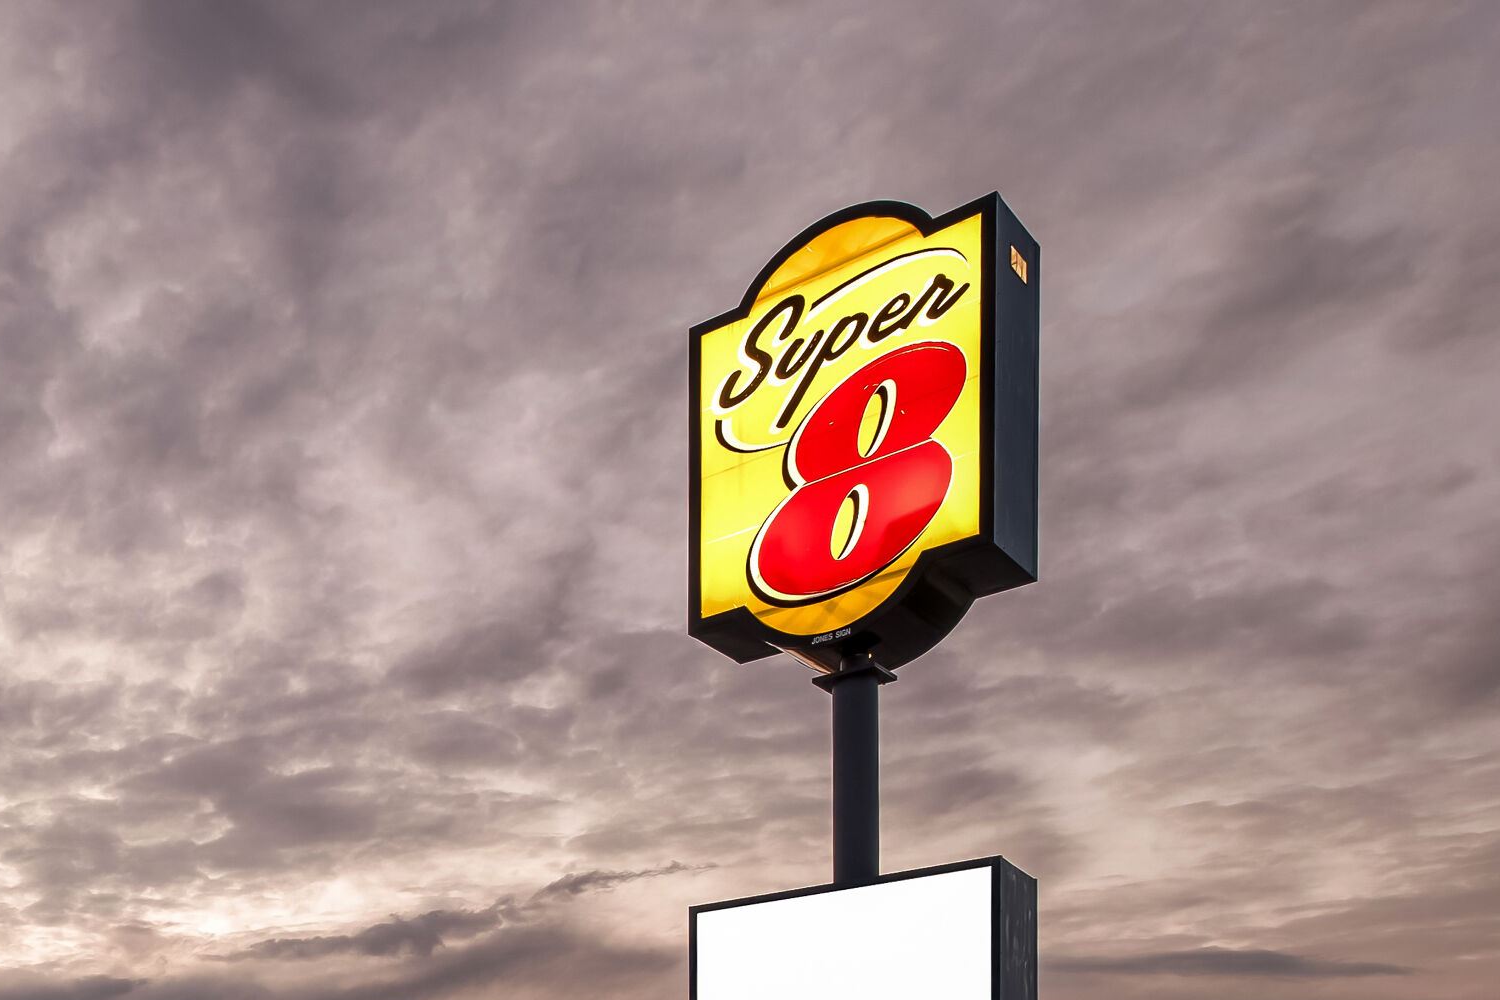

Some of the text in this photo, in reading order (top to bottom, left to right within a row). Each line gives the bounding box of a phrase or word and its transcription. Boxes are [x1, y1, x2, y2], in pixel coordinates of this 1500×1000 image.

[716, 272, 971, 430] Super
[746, 341, 967, 608] 8
[811, 627, 851, 645] JONES SIGN
